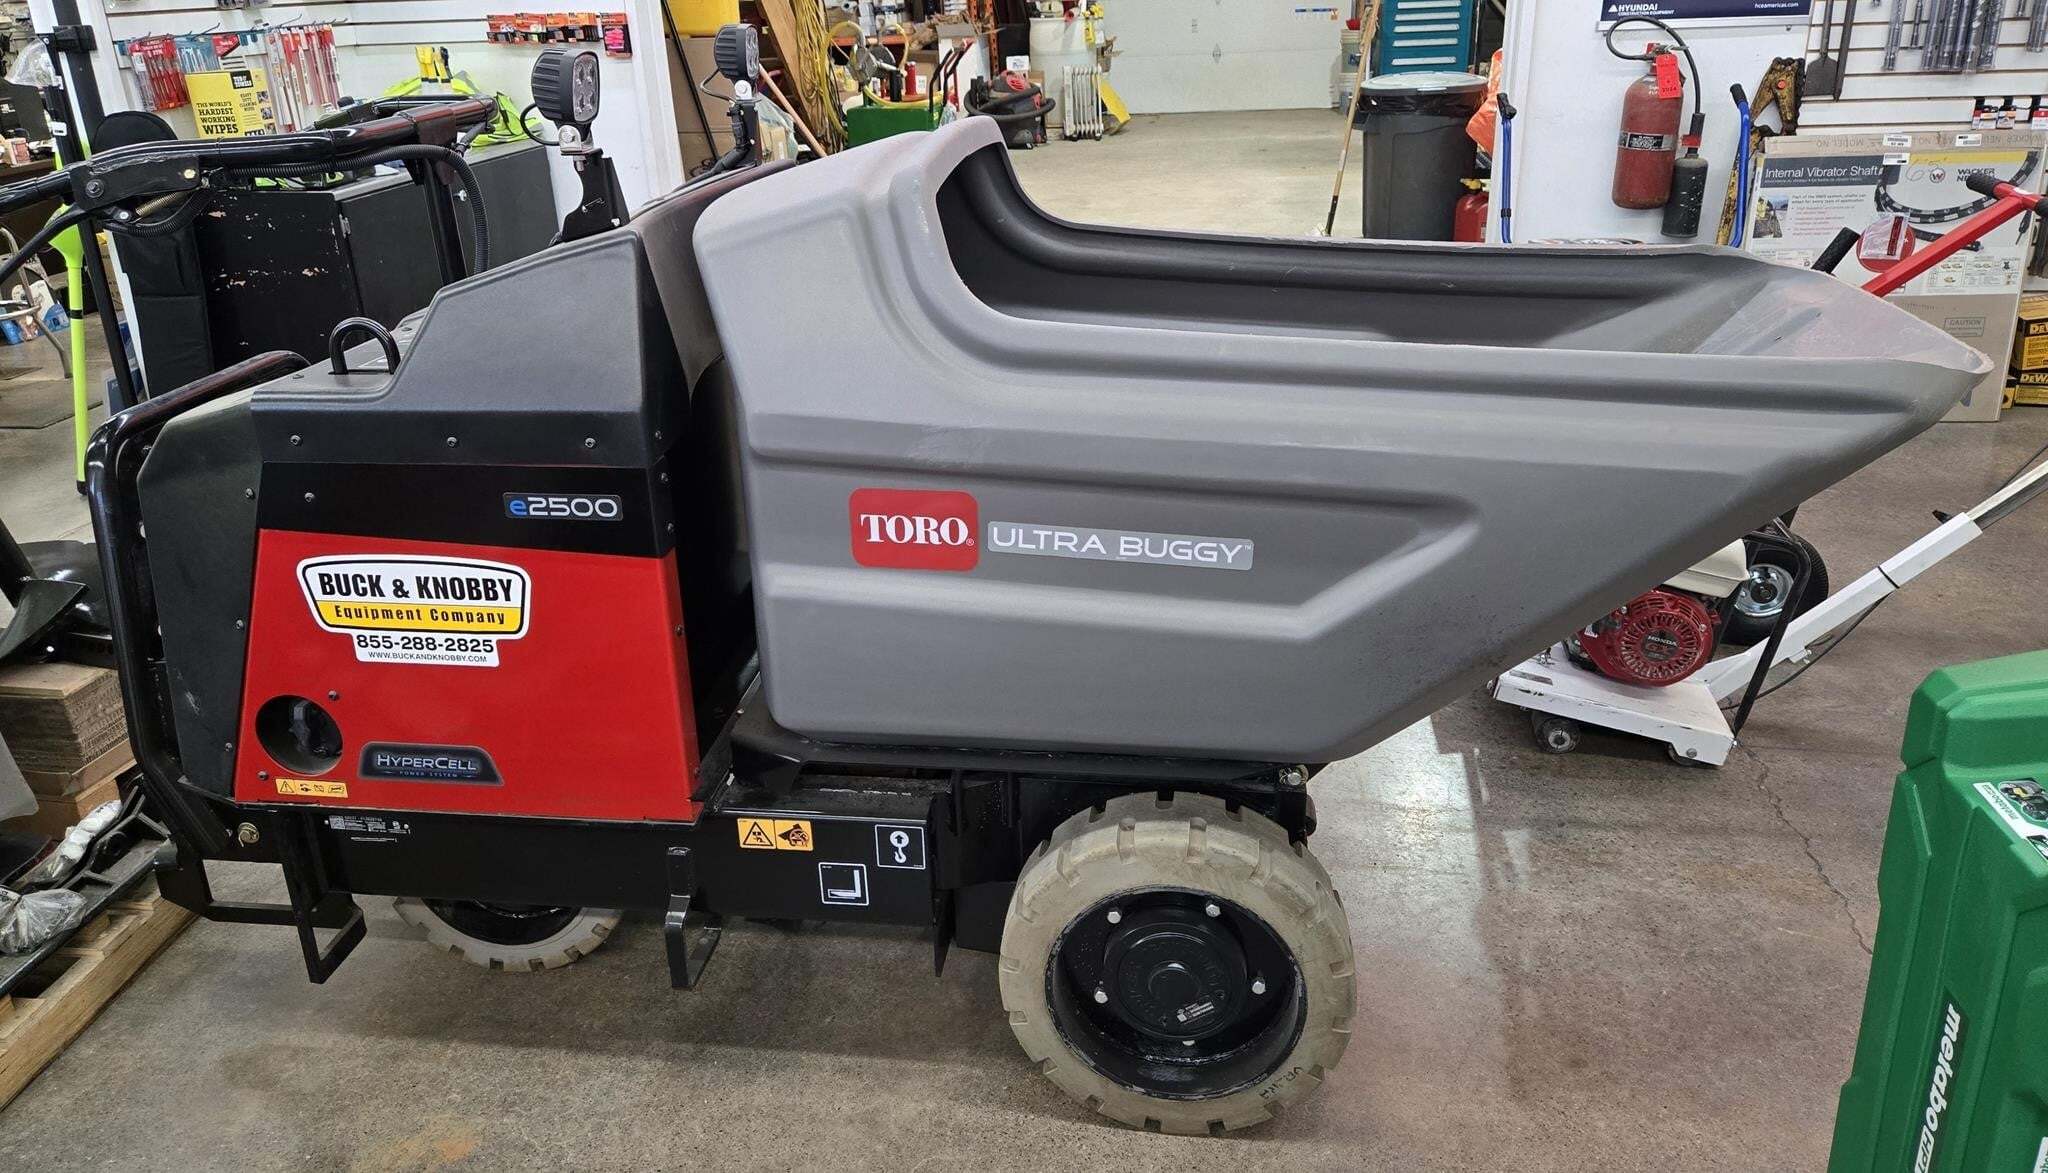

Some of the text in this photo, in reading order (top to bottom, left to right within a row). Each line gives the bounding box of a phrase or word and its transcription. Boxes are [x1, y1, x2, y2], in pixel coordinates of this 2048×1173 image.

[198, 108, 233, 116] HARDEST
[200, 116, 236, 124] WORKING
[203, 124, 239, 135] WIPES
[1765, 168, 1804, 178] Internal
[1806, 167, 1848, 177] Vibrator
[510, 497, 618, 517] e2500
[860, 513, 1242, 564] TORO ULTRA BUGGY
[318, 572, 513, 602] BUCK & KNOBBY
[335, 605, 505, 625] Equipment Company
[356, 634, 494, 653] 855-288-2825
[1648, 635, 1679, 647] HONDA
[368, 651, 488, 663] WWW.BUCKANDKNOBBY.COM
[1926, 1003, 1962, 1132] metabo
